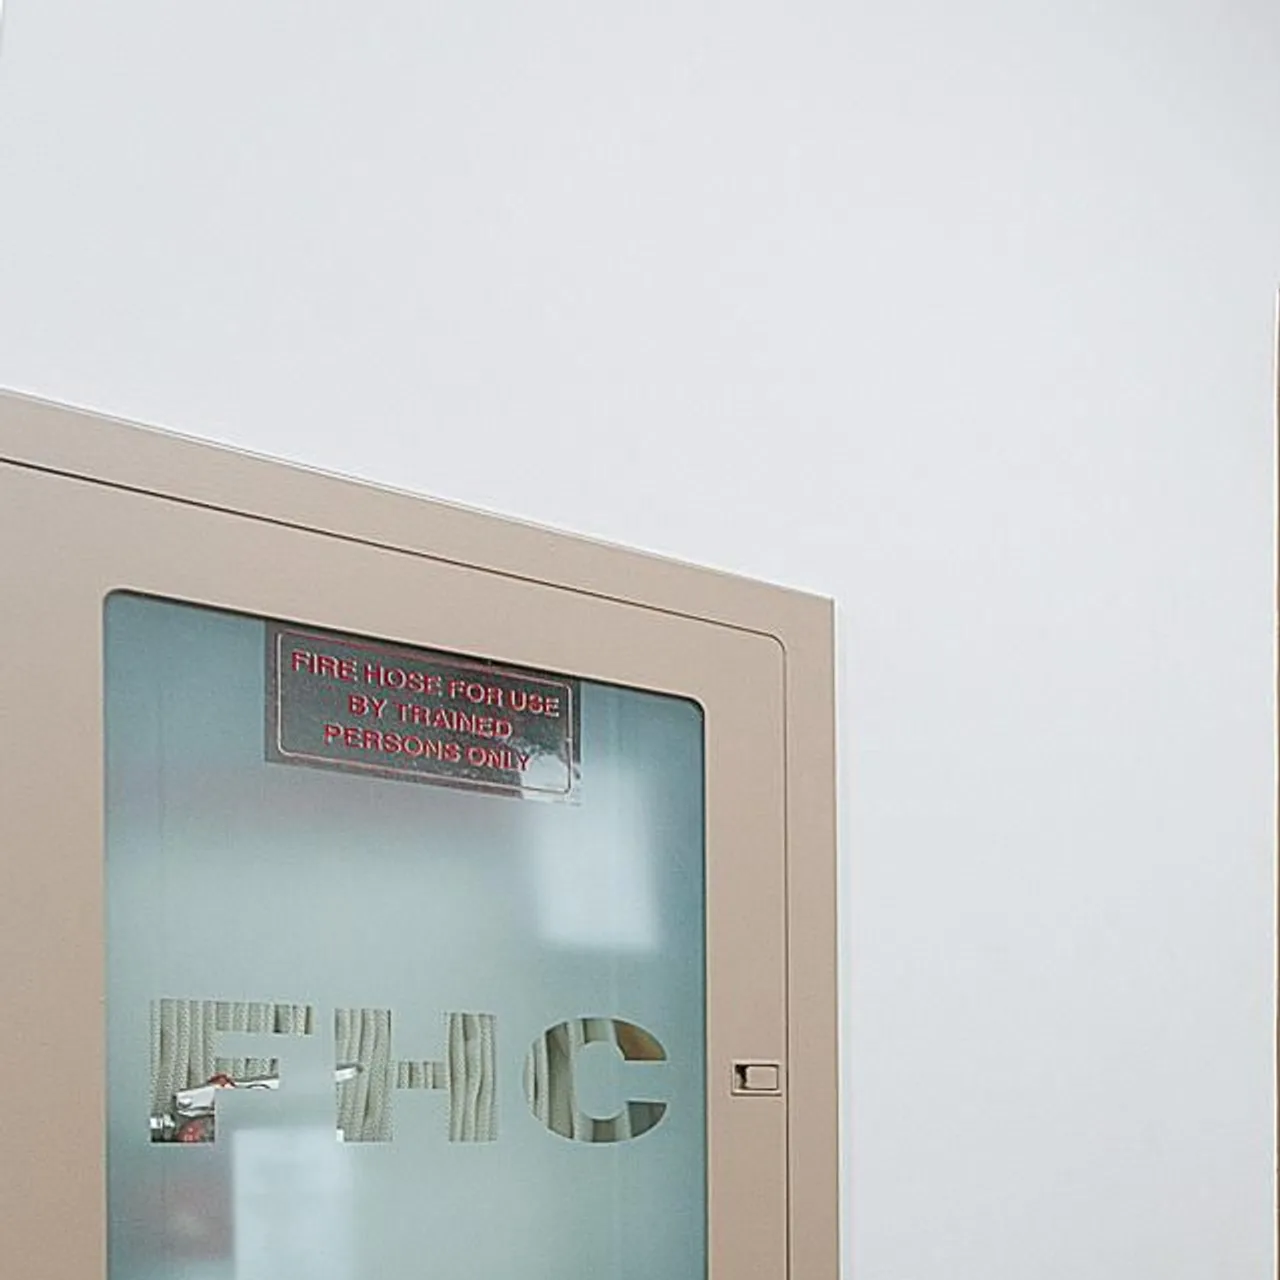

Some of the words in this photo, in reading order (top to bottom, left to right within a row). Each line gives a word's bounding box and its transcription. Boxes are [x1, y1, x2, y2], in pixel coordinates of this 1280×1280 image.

[291, 649, 357, 683] FIRE
[363, 660, 442, 697] HOSE
[448, 680, 503, 707] FOR
[508, 690, 560, 718] USE
[348, 693, 387, 719] BY
[393, 701, 513, 740] TRAINED
[323, 723, 461, 763] PERSONS
[467, 745, 531, 772] ONLY
[150, 998, 668, 1144] FHC
